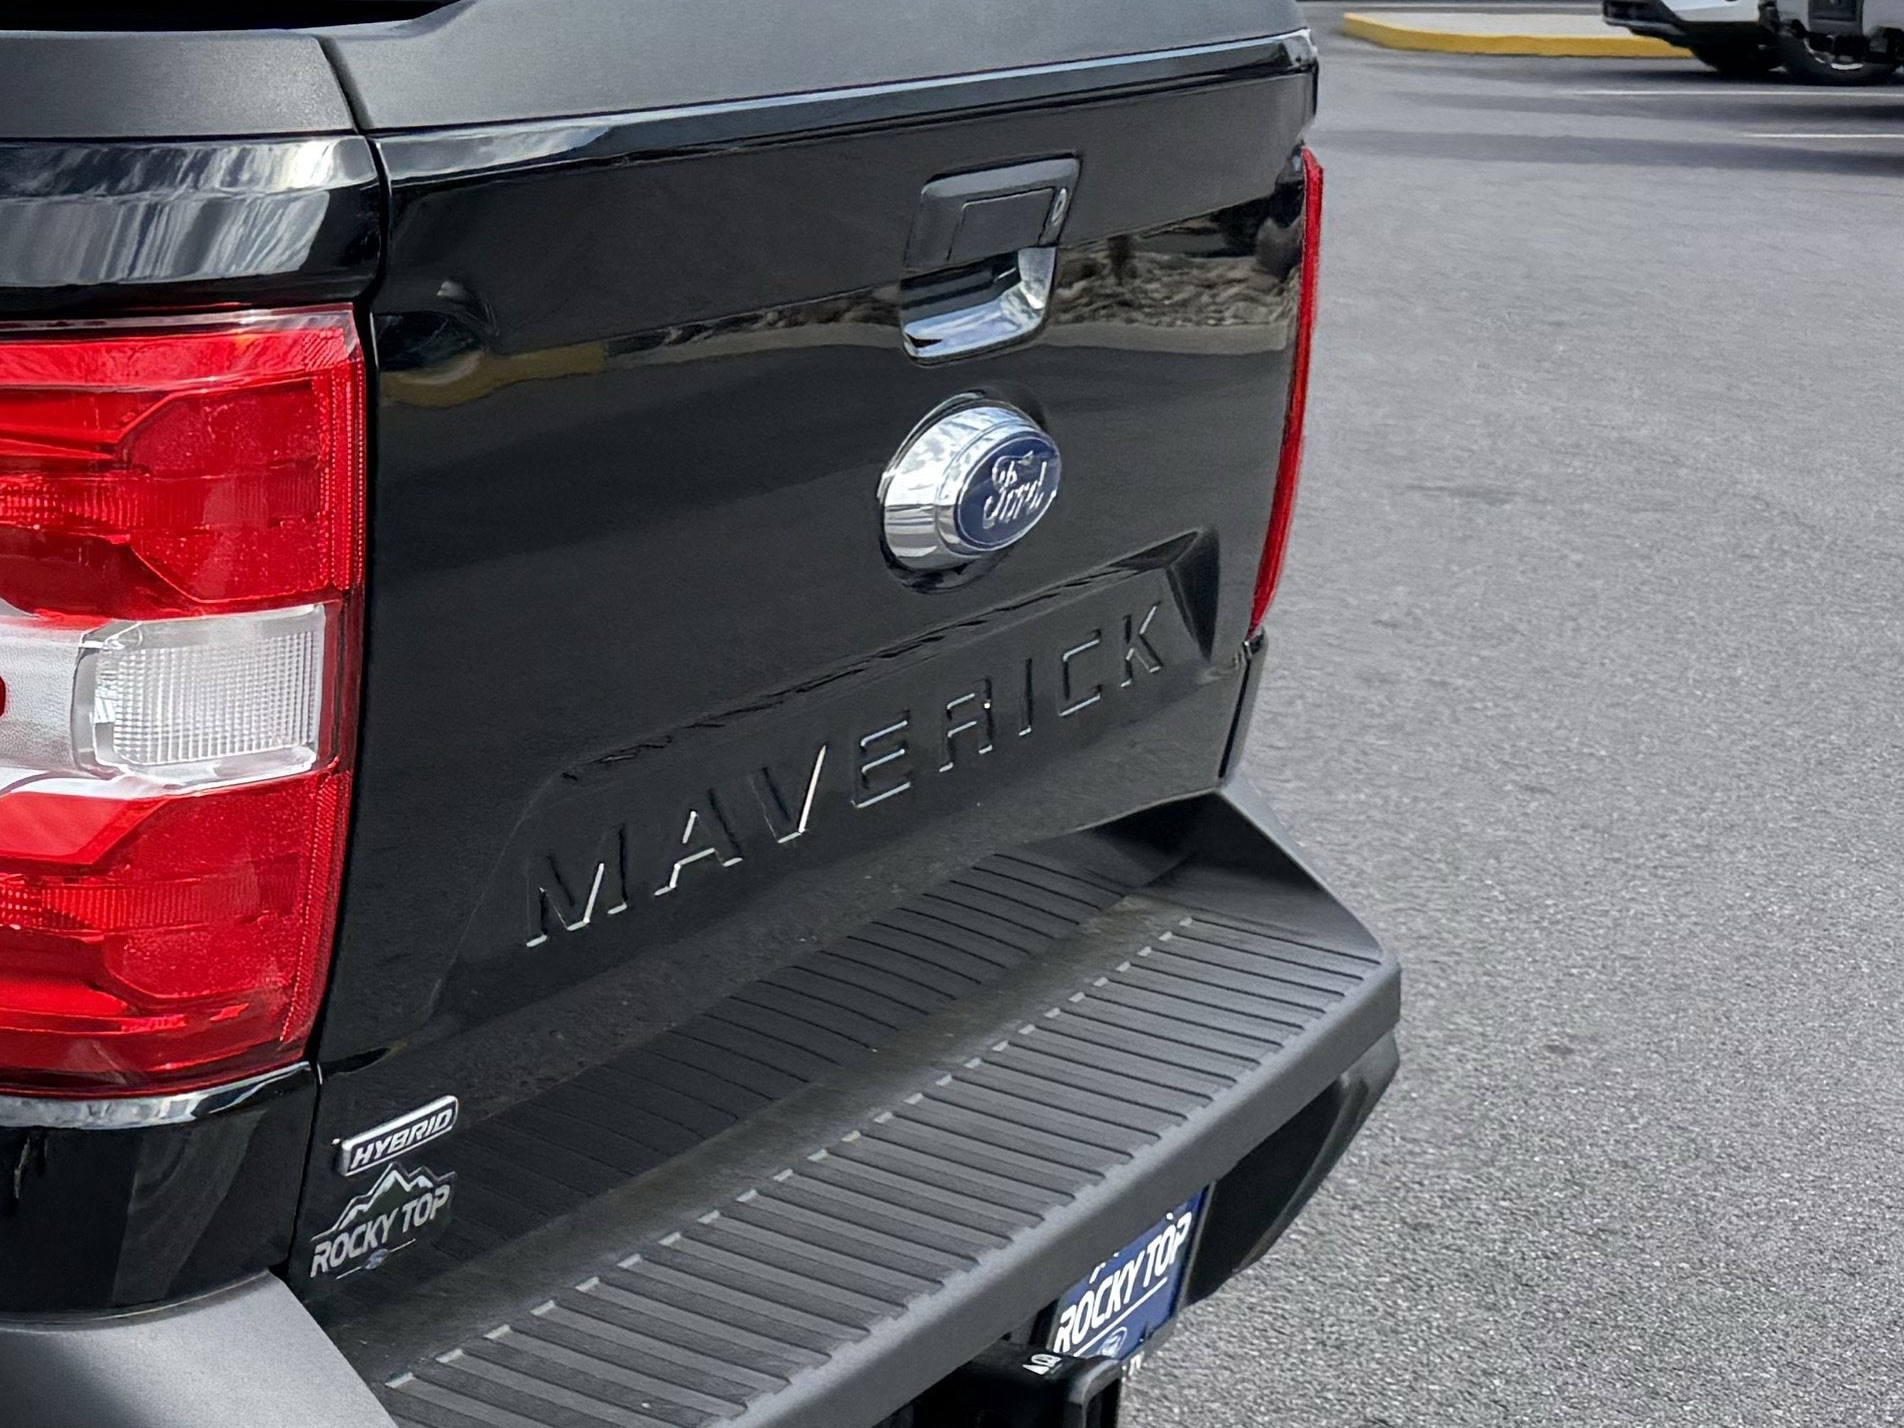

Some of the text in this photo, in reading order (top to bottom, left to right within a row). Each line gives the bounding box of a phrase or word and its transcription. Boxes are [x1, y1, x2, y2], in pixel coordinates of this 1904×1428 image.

[982, 448, 1050, 530] Ford
[525, 599, 1162, 948] MAVERICK
[349, 1107, 454, 1169] HYBRID
[309, 1184, 451, 1278] ROCKY TOP
[1053, 1211, 1193, 1353] ROCKY TOP
